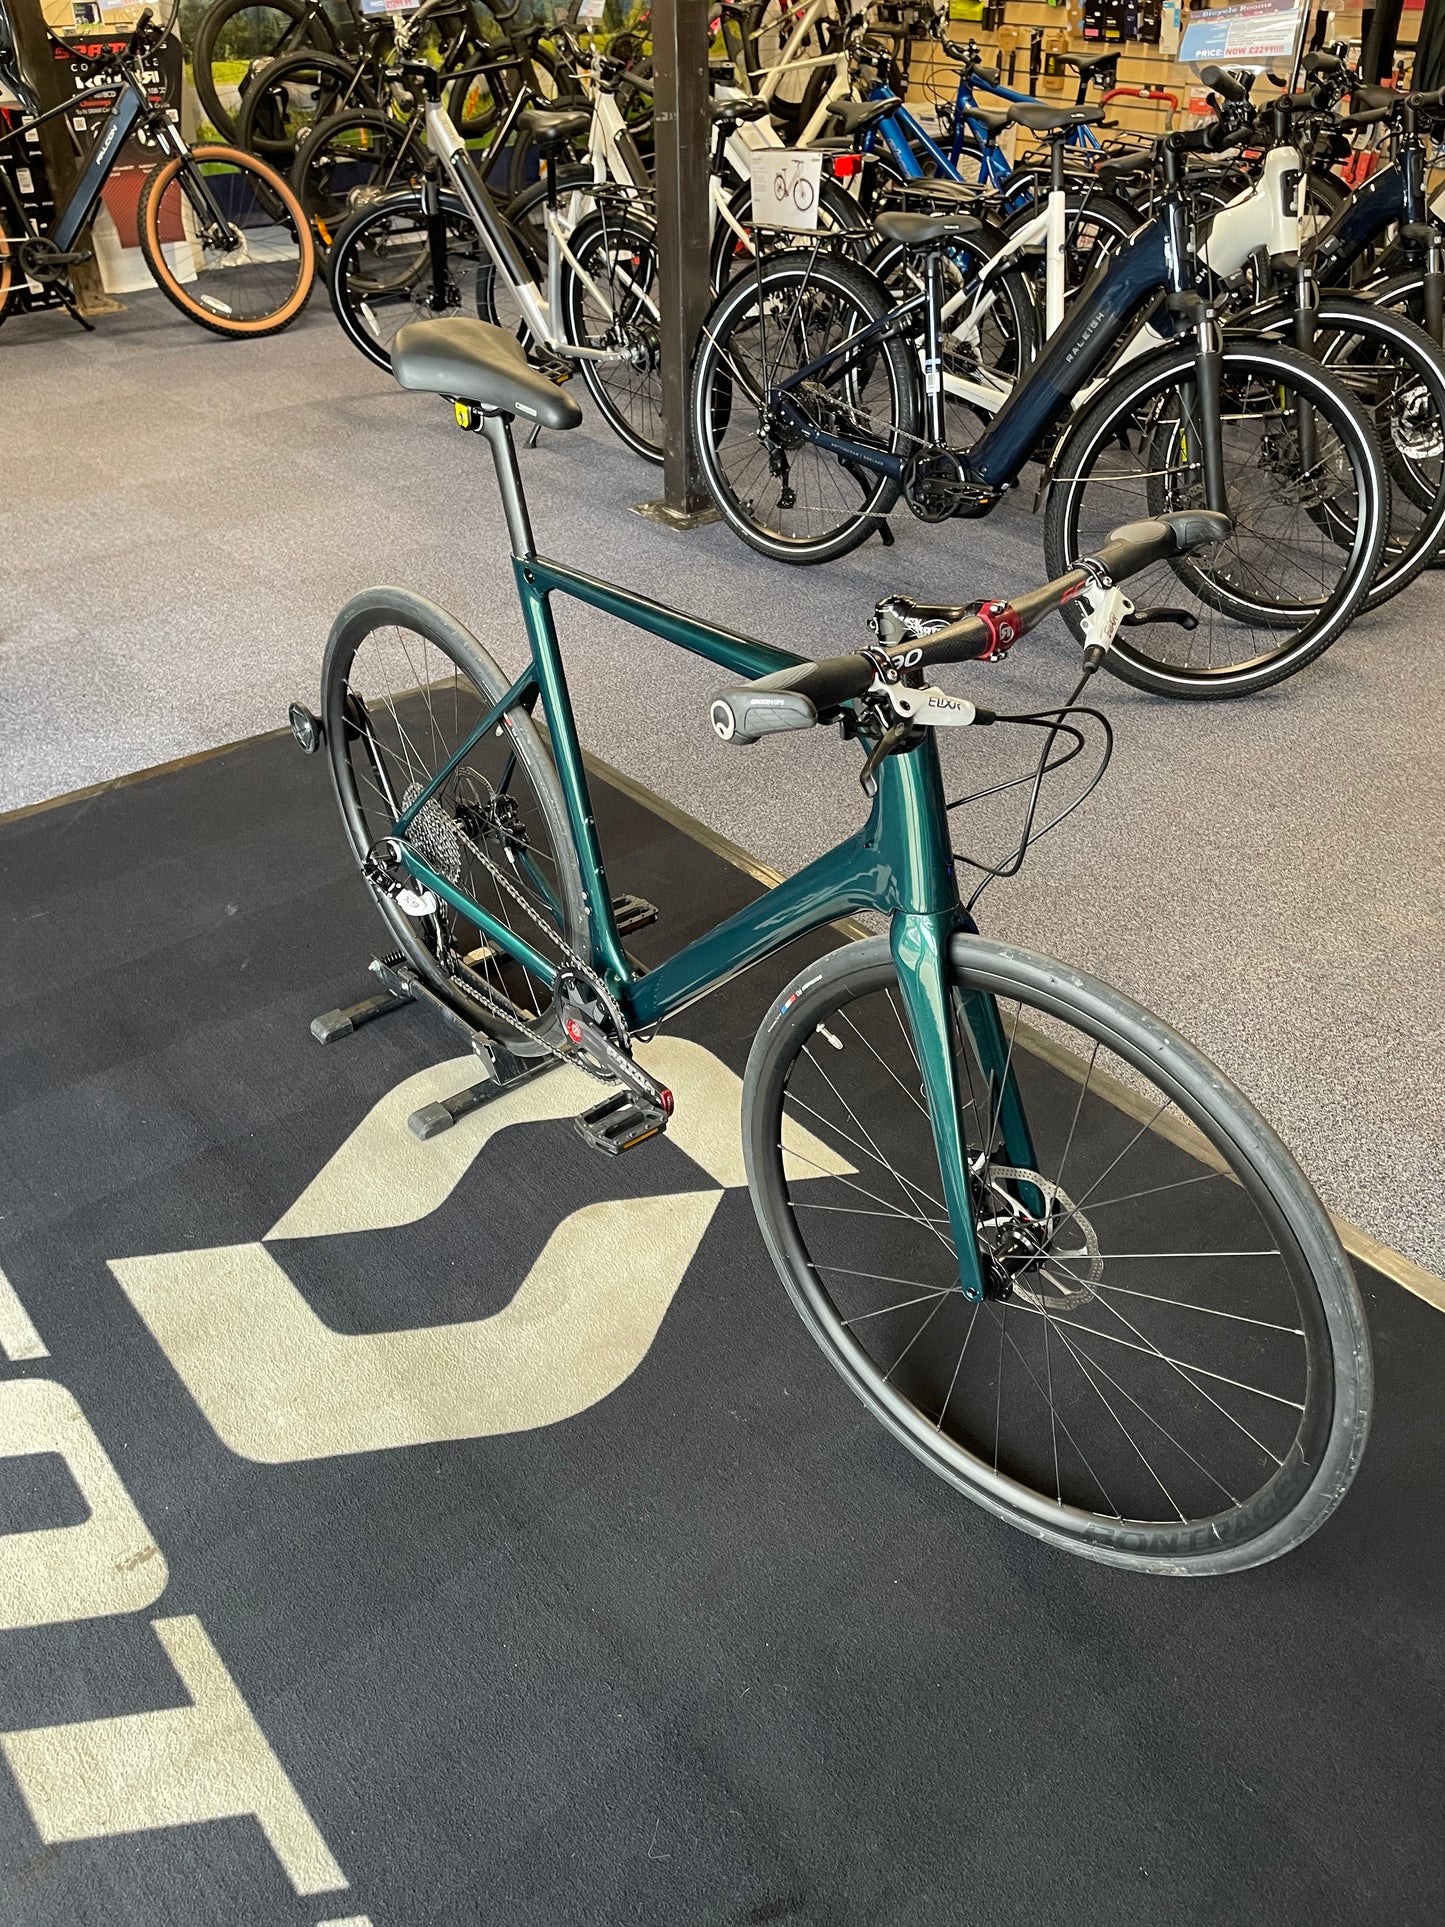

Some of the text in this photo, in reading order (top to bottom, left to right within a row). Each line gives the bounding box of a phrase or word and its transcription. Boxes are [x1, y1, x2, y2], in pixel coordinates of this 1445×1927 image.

[1202, 6, 1238, 18] Bicycle
[1240, 2, 1272, 12] Rooms
[1195, 48, 1224, 58] PRICE:
[1225, 47, 1246, 56] NOW
[95, 124, 118, 165] FALCON
[1065, 311, 1105, 363] RALEIGH
